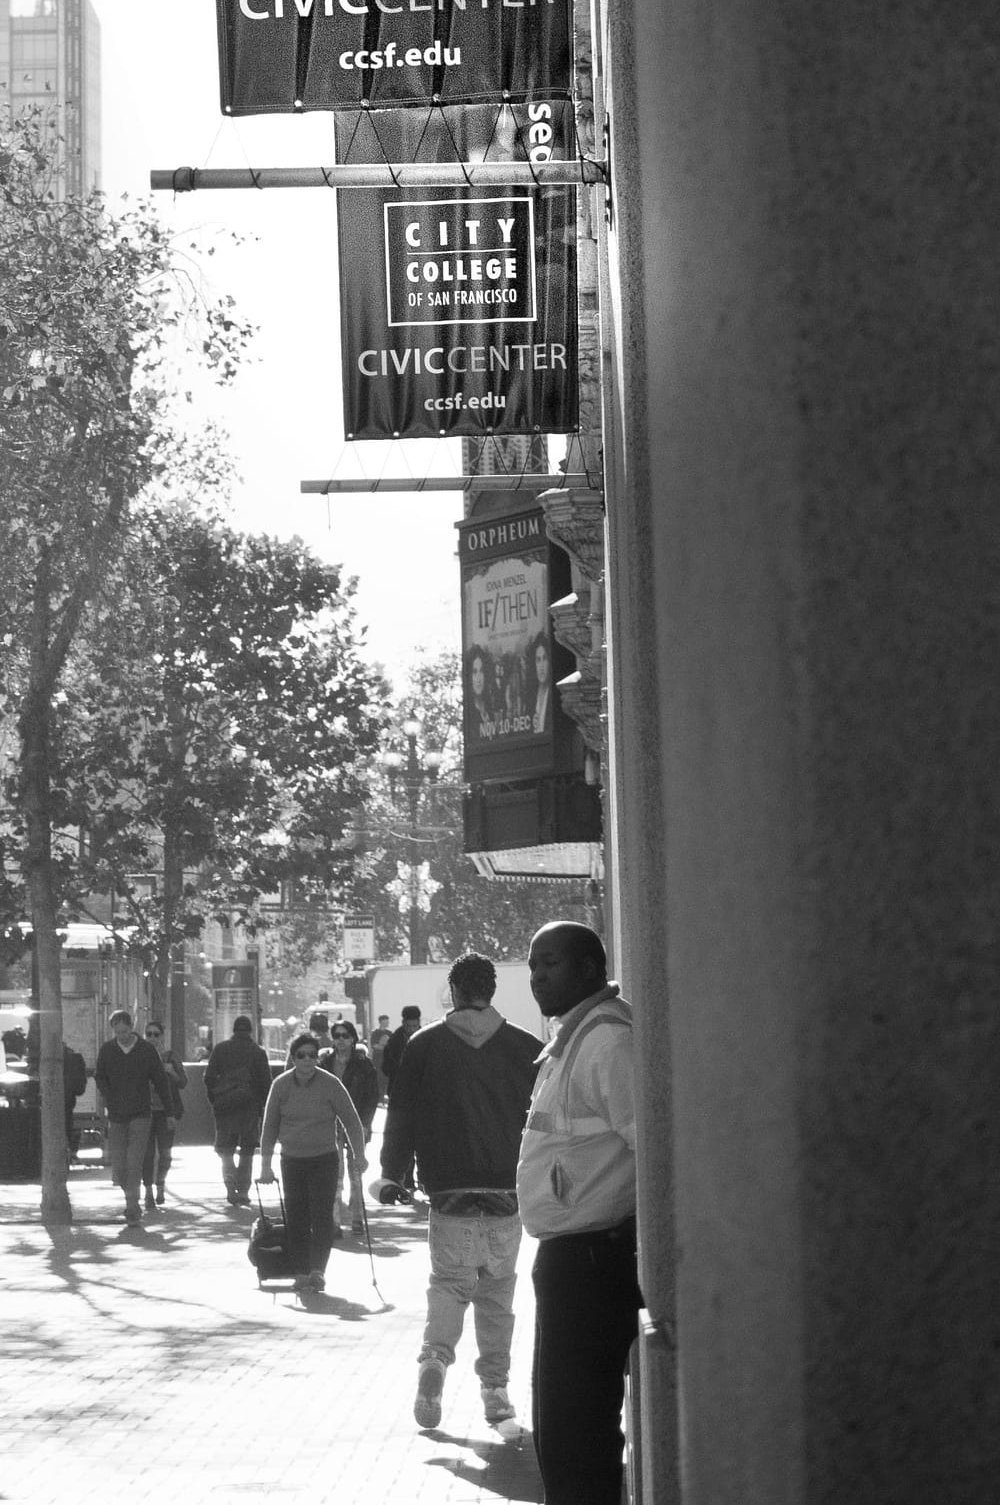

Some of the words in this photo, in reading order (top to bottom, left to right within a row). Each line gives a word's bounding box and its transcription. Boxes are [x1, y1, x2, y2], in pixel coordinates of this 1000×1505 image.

[338, 40, 462, 70] ccsf.edu
[405, 218, 516, 248] CITY
[406, 257, 518, 283] COLLEGE
[408, 292, 424, 307] OF
[428, 291, 450, 306] SAN
[454, 288, 518, 305] FRANCISCO
[424, 391, 507, 411] ccsf.edu
[468, 517, 540, 551] ORPHEUM
